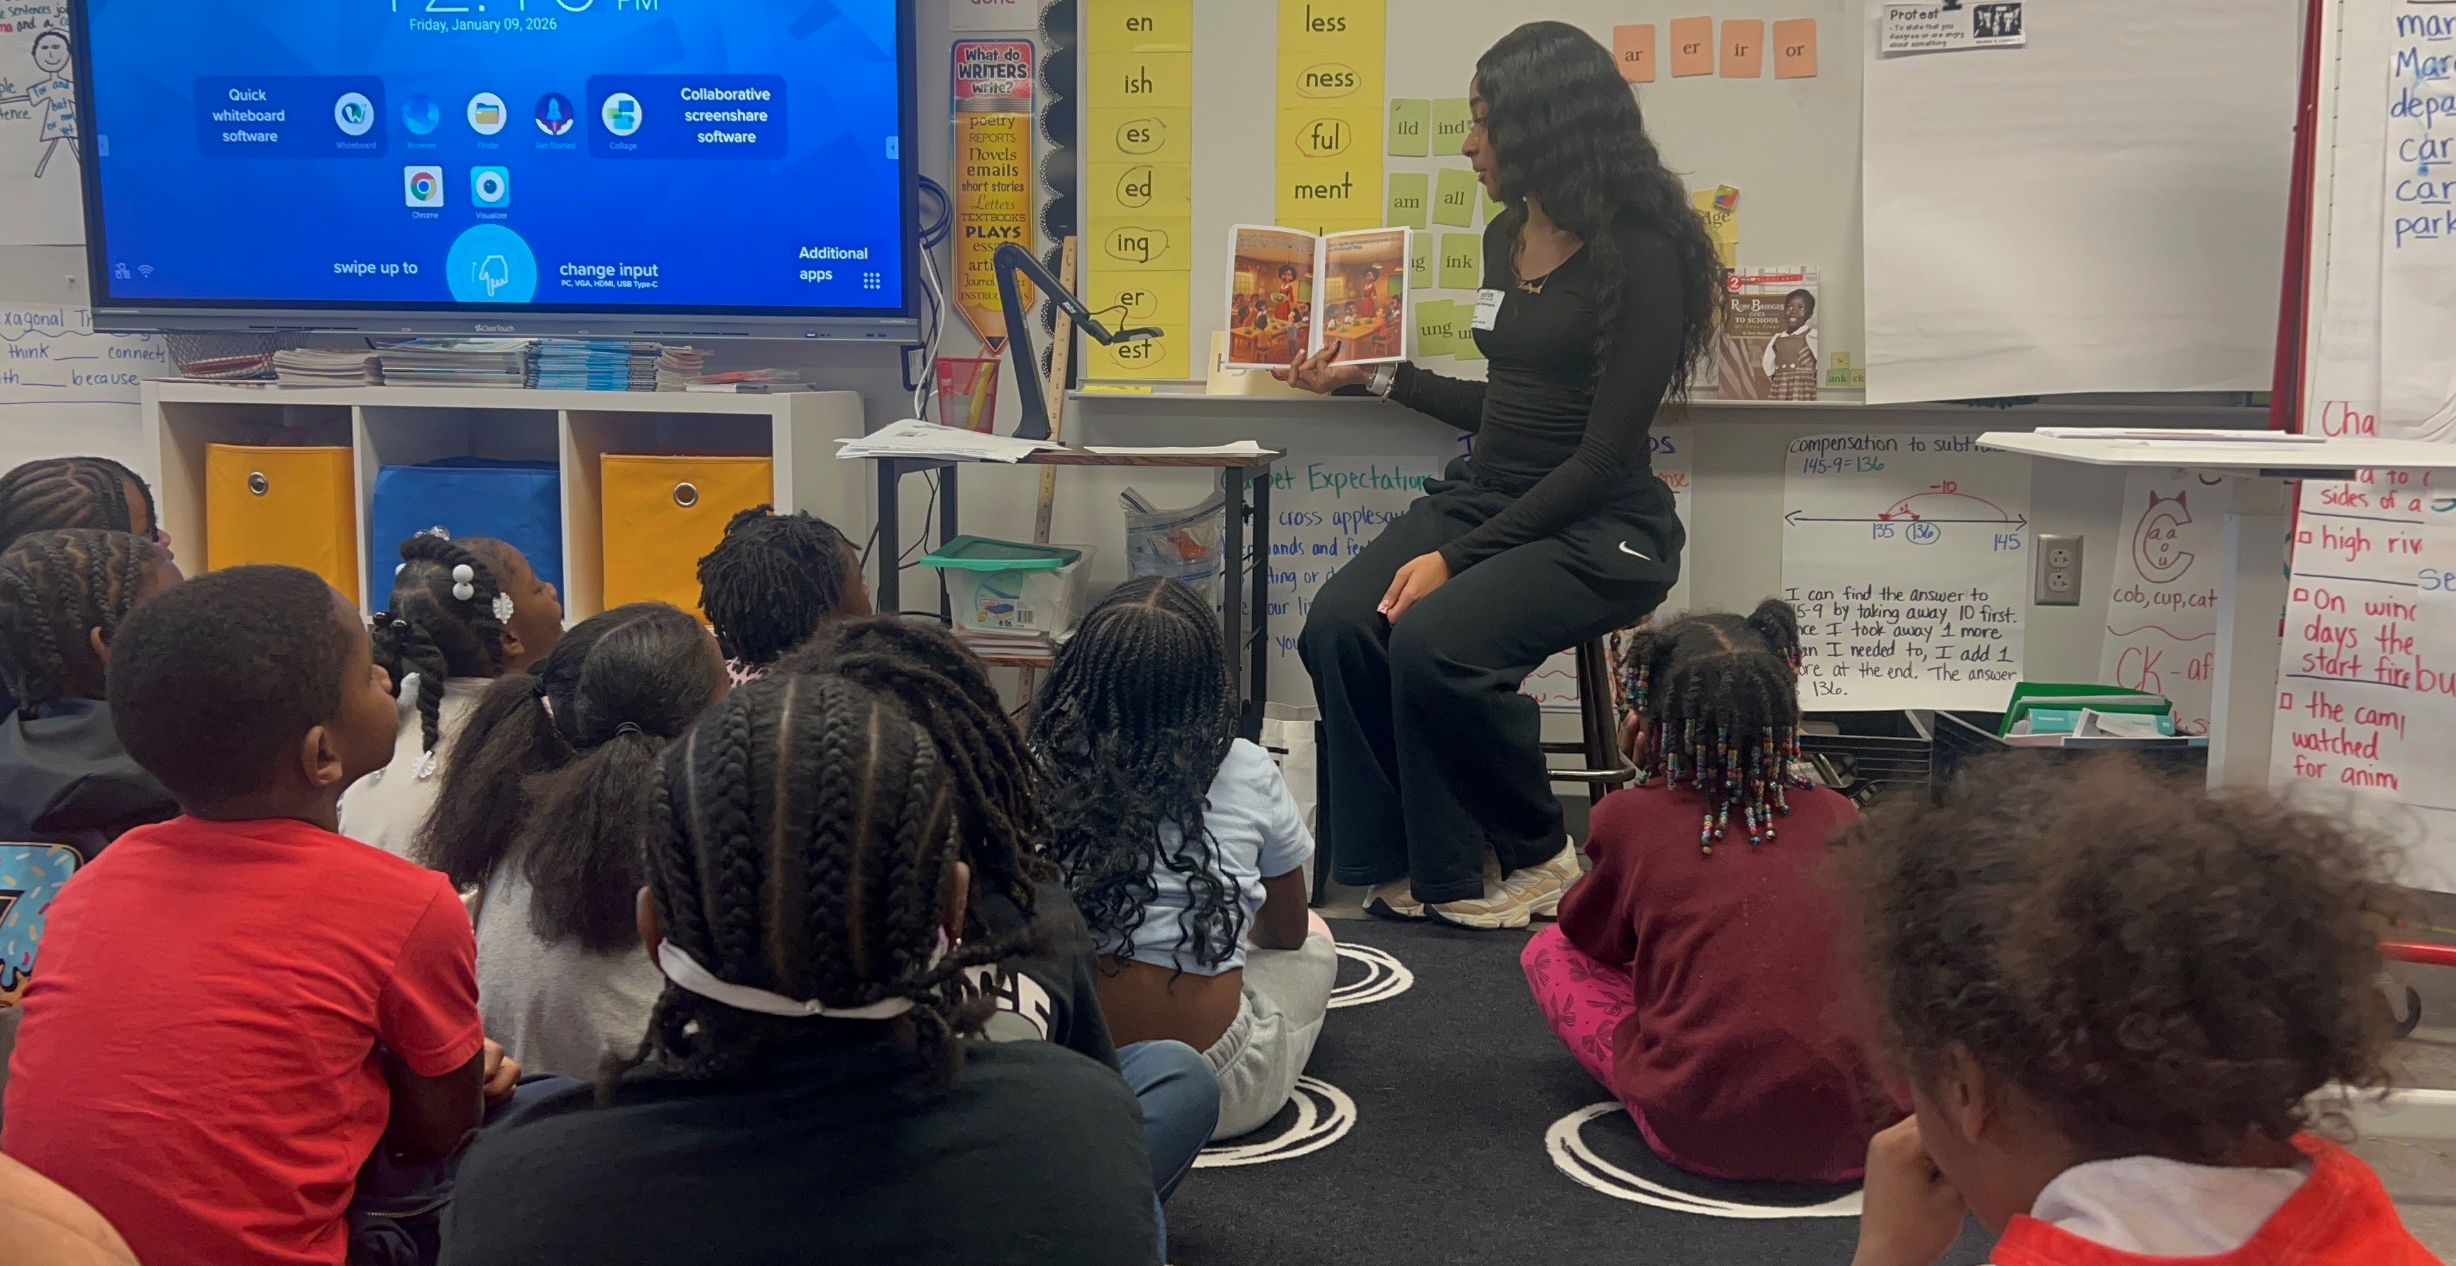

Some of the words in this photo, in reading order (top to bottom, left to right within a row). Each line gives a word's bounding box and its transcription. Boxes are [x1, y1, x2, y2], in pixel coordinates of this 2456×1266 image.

[8, 4, 52, 17] sentences
[1890, 8, 1940, 21] Protest
[17, 16, 37, 32] and
[43, 19, 54, 28] a
[410, 18, 449, 33] Friday,
[452, 18, 501, 33] January
[504, 18, 523, 32] 09,
[525, 17, 557, 31] 2026
[1126, 16, 1153, 32] en
[1306, 4, 1347, 33] less
[1906, 23, 1924, 31] state
[1683, 42, 1701, 54] er
[1734, 43, 1749, 57] ir
[1785, 43, 1805, 57] or
[1911, 40, 1947, 48] something
[966, 47, 999, 61] What
[1004, 48, 1021, 61] do
[1624, 49, 1643, 62] ar
[959, 64, 1028, 79] WRITERS
[972, 81, 1014, 94] write?
[1124, 66, 1153, 94] ish
[1306, 73, 1354, 88] ness
[228, 88, 267, 102] Quick
[681, 87, 771, 101] Collaborative
[212, 109, 285, 122] whiteboard
[685, 109, 768, 122] screenshare
[969, 117, 1016, 129] poetry
[1397, 121, 1419, 135] ild
[1438, 120, 1465, 135] ind
[222, 129, 278, 143] software
[697, 130, 757, 144] software
[969, 133, 1016, 143] REPORTS
[1126, 128, 1150, 143] es
[1311, 122, 1339, 150] ful
[336, 142, 376, 150] Whiteboard
[407, 141, 437, 150] Browser
[477, 141, 500, 150] Finder
[535, 142, 549, 150] Get
[550, 142, 576, 150] Started
[609, 142, 637, 151] Collage
[968, 148, 1017, 161] Novels
[966, 165, 1019, 177] emails
[961, 181, 988, 192] short
[992, 182, 1025, 192] stories
[1125, 170, 1152, 198] ed
[1295, 171, 1353, 199] ment
[970, 194, 1016, 210] Letters
[1394, 196, 1420, 209] am
[1444, 191, 1465, 206] all
[412, 211, 439, 220] Chrome
[475, 211, 508, 220] Visualizer
[961, 213, 1026, 222] TEXTBOOKS
[966, 226, 1021, 239] PLAYS
[799, 247, 868, 260] Additional
[1117, 233, 1149, 263] ing
[334, 260, 377, 276] swipe
[380, 263, 399, 276] up
[402, 261, 418, 274] to
[1445, 254, 1473, 269] ink
[559, 262, 616, 279] change
[619, 262, 658, 278] input
[800, 269, 833, 283] apps
[561, 280, 574, 288] PC,
[574, 280, 593, 288] VGA,
[593, 280, 616, 288] HDMI,
[616, 280, 633, 288] USB
[633, 281, 658, 289] Type-C
[1730, 277, 1739, 288] 2
[1120, 292, 1144, 306] er
[1421, 322, 1453, 338] ung
[8, 343, 50, 359] think
[108, 344, 166, 363] connects
[1118, 338, 1152, 359] est
[72, 369, 141, 386] because
[1828, 374, 1847, 383] ank
[1789, 435, 1898, 458] compensation
[1908, 436, 1926, 451] to
[2386, 470, 2408, 485] to
[2321, 483, 2370, 508] sides
[2380, 490, 2398, 510] of
[2408, 498, 2421, 512] a
[1279, 509, 1323, 527] cross
[1872, 523, 1895, 540] 135
[1912, 522, 1935, 540] 136
[1994, 533, 2021, 552] 145
[2323, 524, 2371, 563] high
[1312, 536, 1338, 556] and
[1304, 570, 1320, 584] or
[1785, 588, 1800, 601] I
[1808, 590, 1834, 601] can
[1843, 583, 1872, 601] find
[1879, 586, 1905, 601] the
[1910, 589, 1964, 602] answer
[1970, 588, 1989, 602] to
[2314, 588, 2345, 614] On
[1834, 601, 1849, 621] by
[1857, 603, 1900, 624] taking
[1906, 607, 1948, 625] away
[1960, 605, 1975, 621] 10
[1979, 604, 2018, 624] first.
[1826, 622, 1842, 637] I
[1851, 620, 1886, 637] took
[1893, 626, 1934, 644] away
[1941, 622, 1957, 638] 1
[1961, 627, 2003, 640] more
[2304, 614, 2358, 659] days
[1826, 642, 1844, 657] I
[1850, 639, 1896, 658] needed
[1906, 642, 1928, 663] to,
[1935, 645, 1956, 660] I
[1960, 643, 1991, 662] add
[1997, 645, 2015, 663] 1
[2116, 646, 2162, 694] CK
[2302, 647, 2362, 678] start
[1832, 661, 1851, 677] at
[1858, 661, 1883, 678] the
[1887, 661, 1918, 680] end.
[1927, 662, 1961, 681] The
[1969, 668, 2017, 681] answer
[1813, 681, 1848, 697] 136.
[2306, 691, 2344, 723] the
[2292, 727, 2379, 760] watched
[2293, 754, 2327, 778] for
